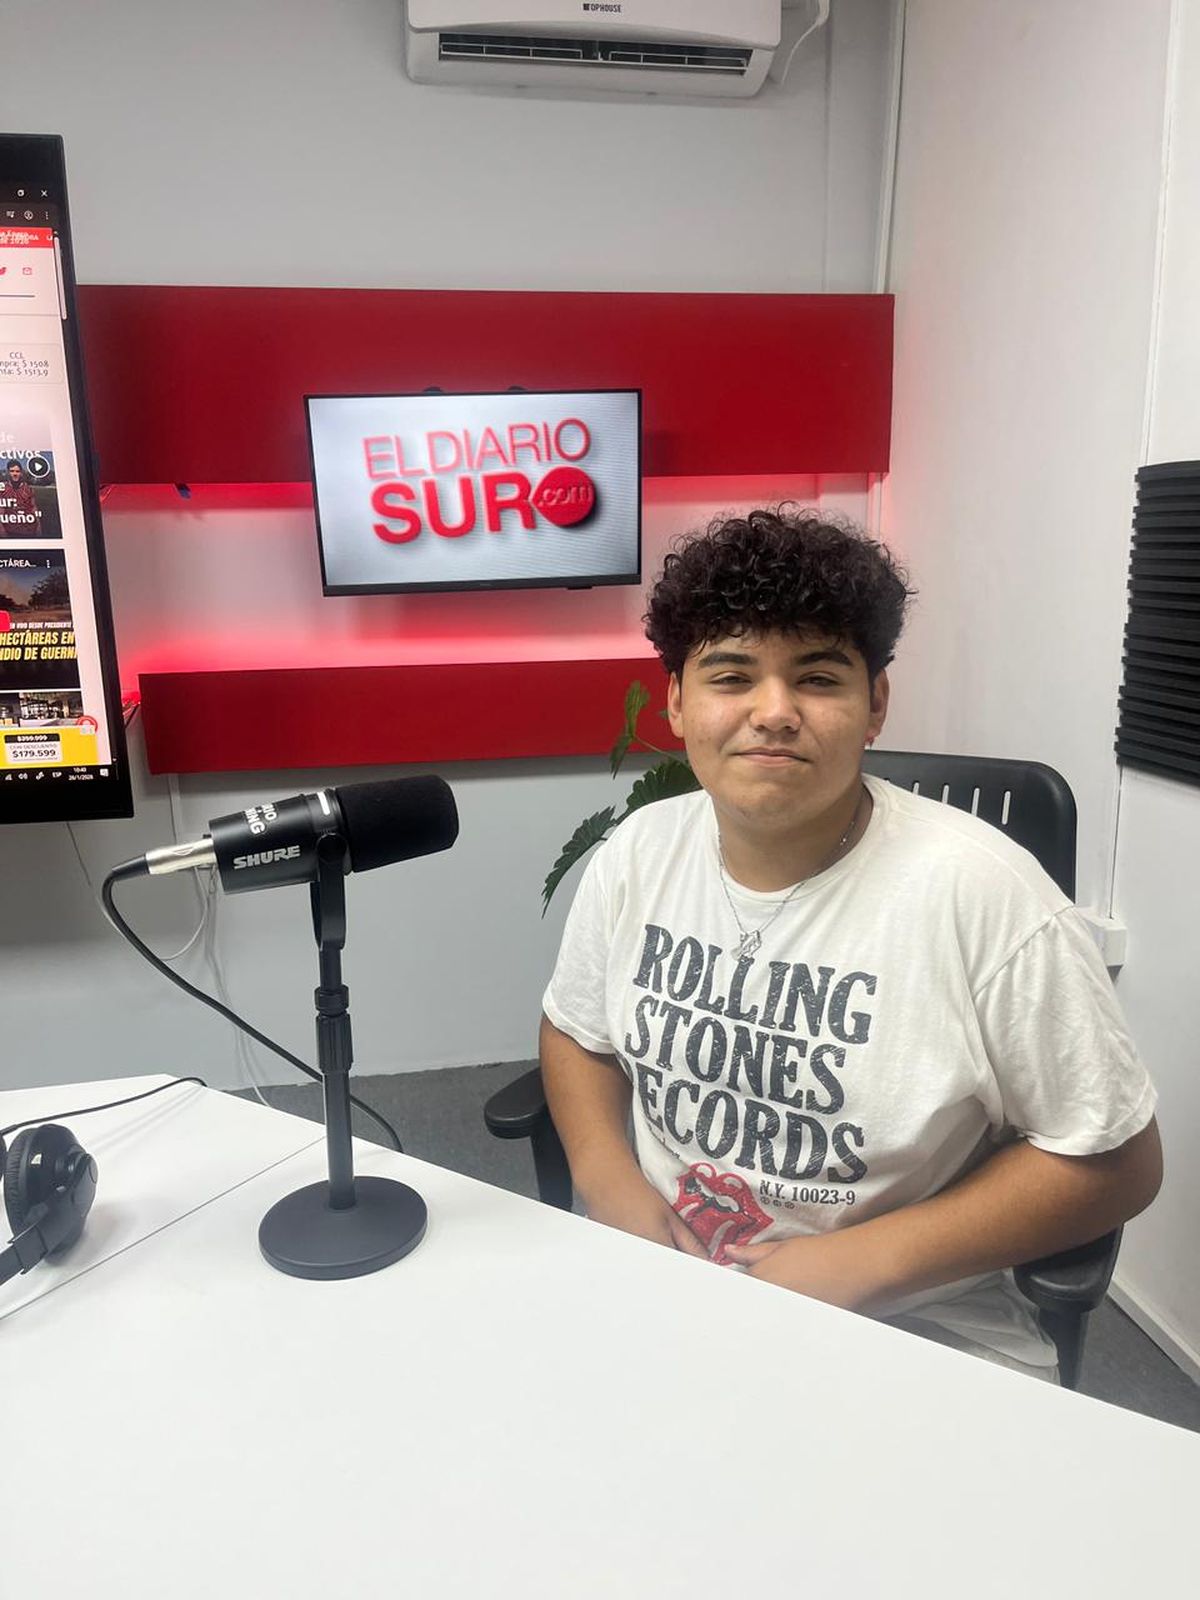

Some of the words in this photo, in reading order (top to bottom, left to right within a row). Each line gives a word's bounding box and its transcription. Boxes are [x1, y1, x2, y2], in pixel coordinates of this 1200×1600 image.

[10, 351, 24, 359] CCL
[426, 417, 591, 474] DIARIO
[370, 471, 536, 544] SUR
[24, 647, 38, 660] DE
[12, 750, 56, 758] $179.599
[233, 845, 301, 870] SHURE
[633, 923, 877, 1044] ROLLING
[624, 995, 846, 1115] STONES
[791, 1187, 856, 1205] 10023-9
